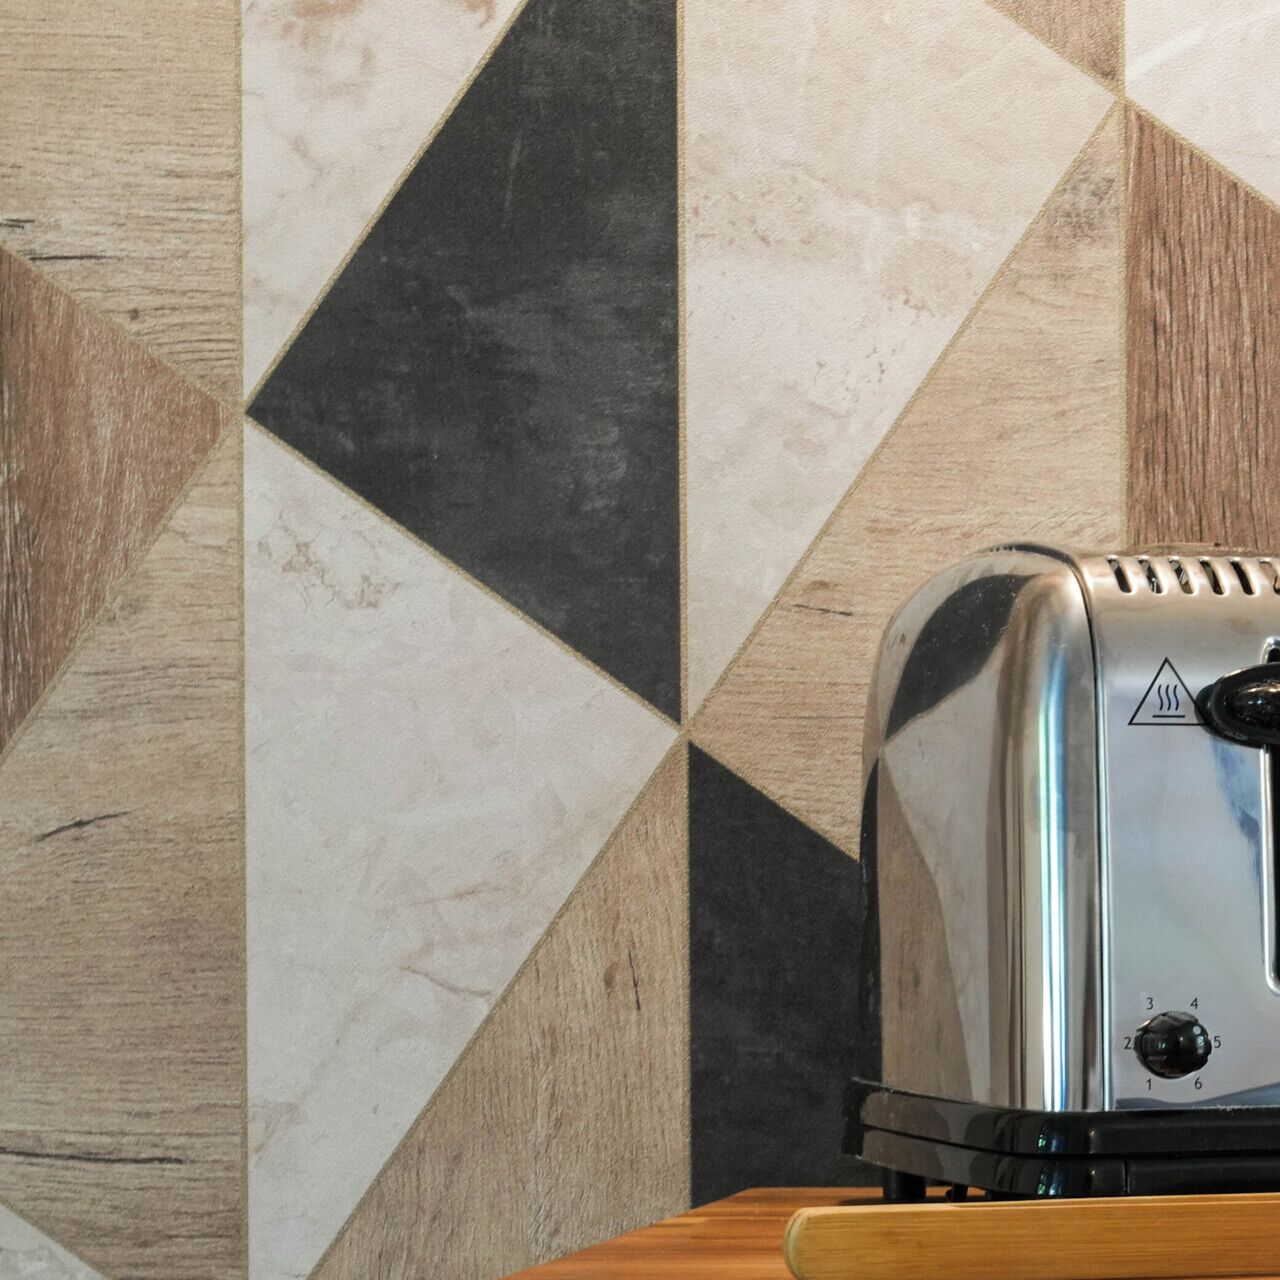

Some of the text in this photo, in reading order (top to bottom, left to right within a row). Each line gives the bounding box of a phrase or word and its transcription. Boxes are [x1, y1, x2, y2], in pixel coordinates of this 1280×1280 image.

[1146, 997, 1154, 1010] 3
[1190, 997, 1199, 1010] 4
[1124, 1037, 1132, 1049] 2
[1214, 1036, 1221, 1048] 5
[1146, 1078, 1152, 1090] 1
[1194, 1076, 1202, 1090] 6
